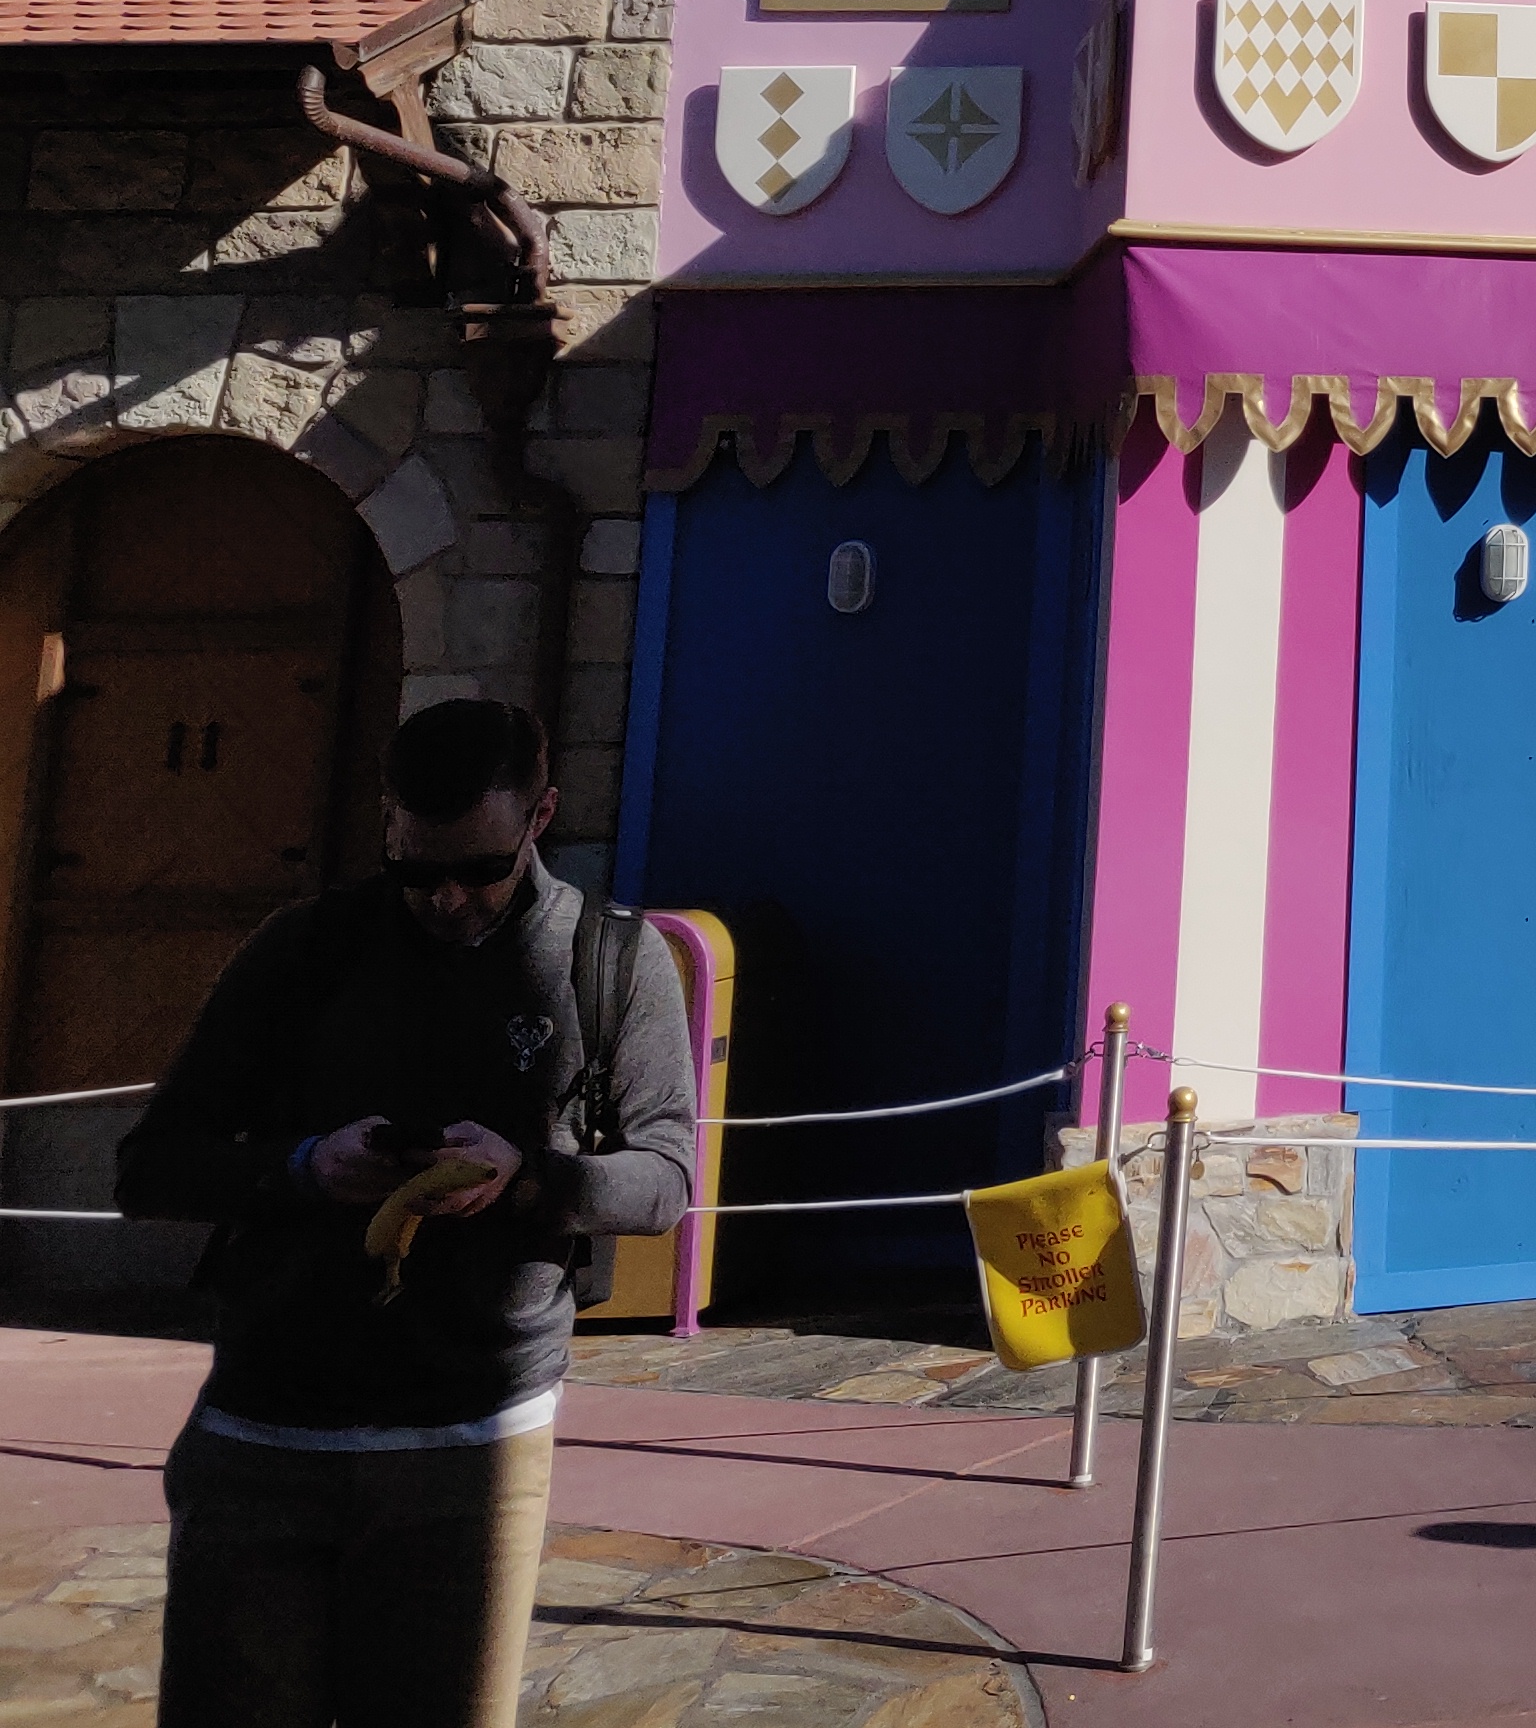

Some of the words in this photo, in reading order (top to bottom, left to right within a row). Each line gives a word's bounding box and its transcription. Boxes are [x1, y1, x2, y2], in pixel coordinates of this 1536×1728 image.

[1016, 1224, 1084, 1250] Please
[1037, 1251, 1071, 1267] No
[1018, 1261, 1105, 1294] Stroller
[1021, 1283, 1107, 1318] Parking
